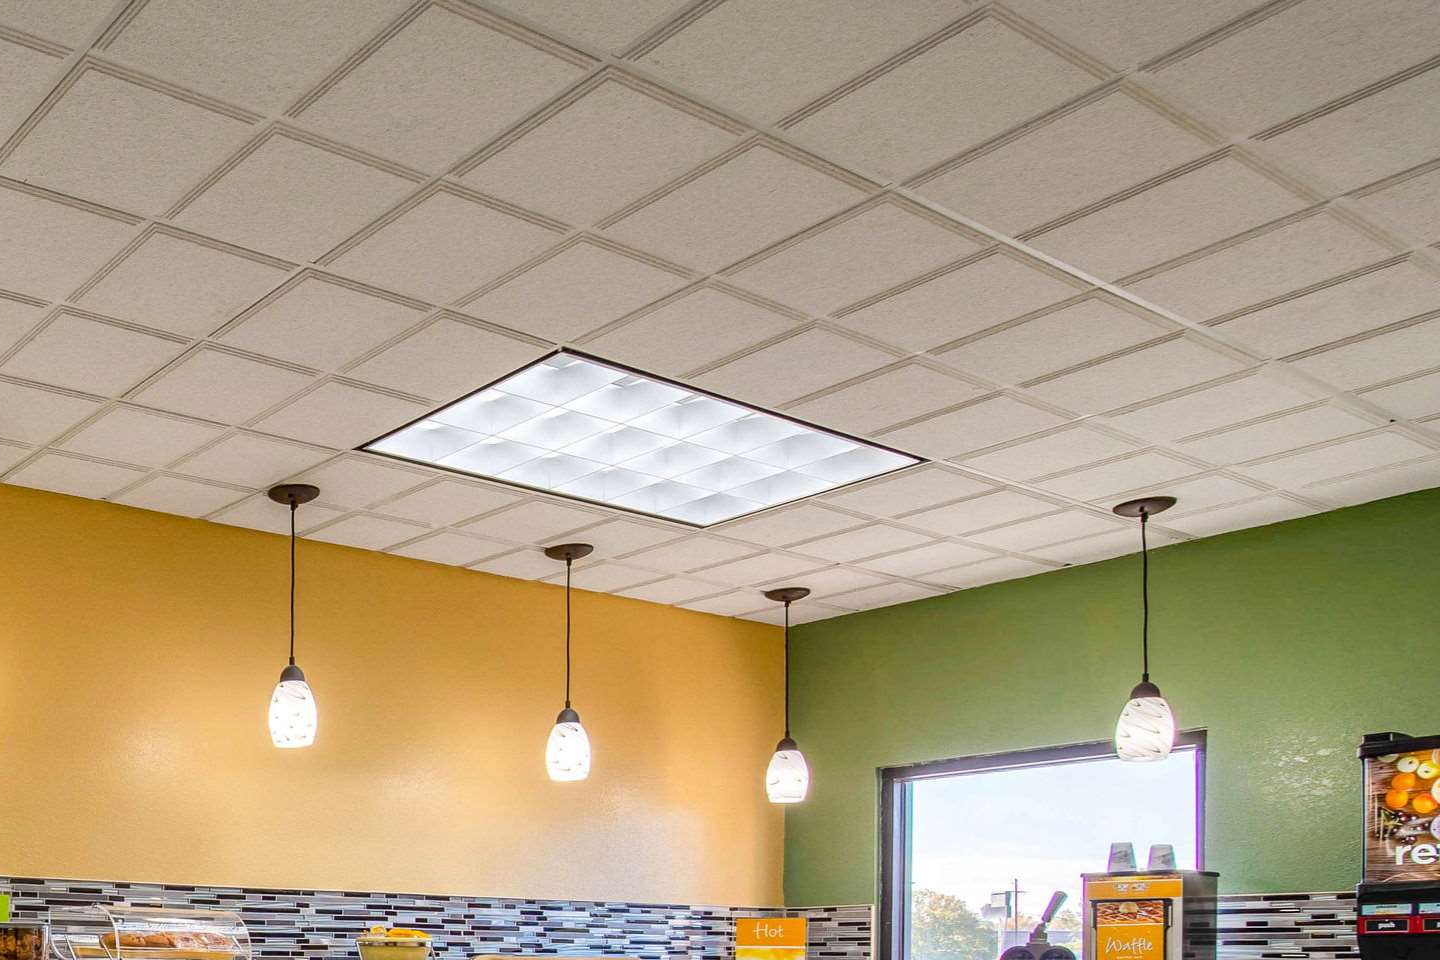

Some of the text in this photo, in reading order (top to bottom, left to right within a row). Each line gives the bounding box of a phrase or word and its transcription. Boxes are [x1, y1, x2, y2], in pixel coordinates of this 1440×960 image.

[1395, 843, 1440, 865] re
[752, 921, 784, 940] Hot
[1105, 937, 1153, 954] Waffle
